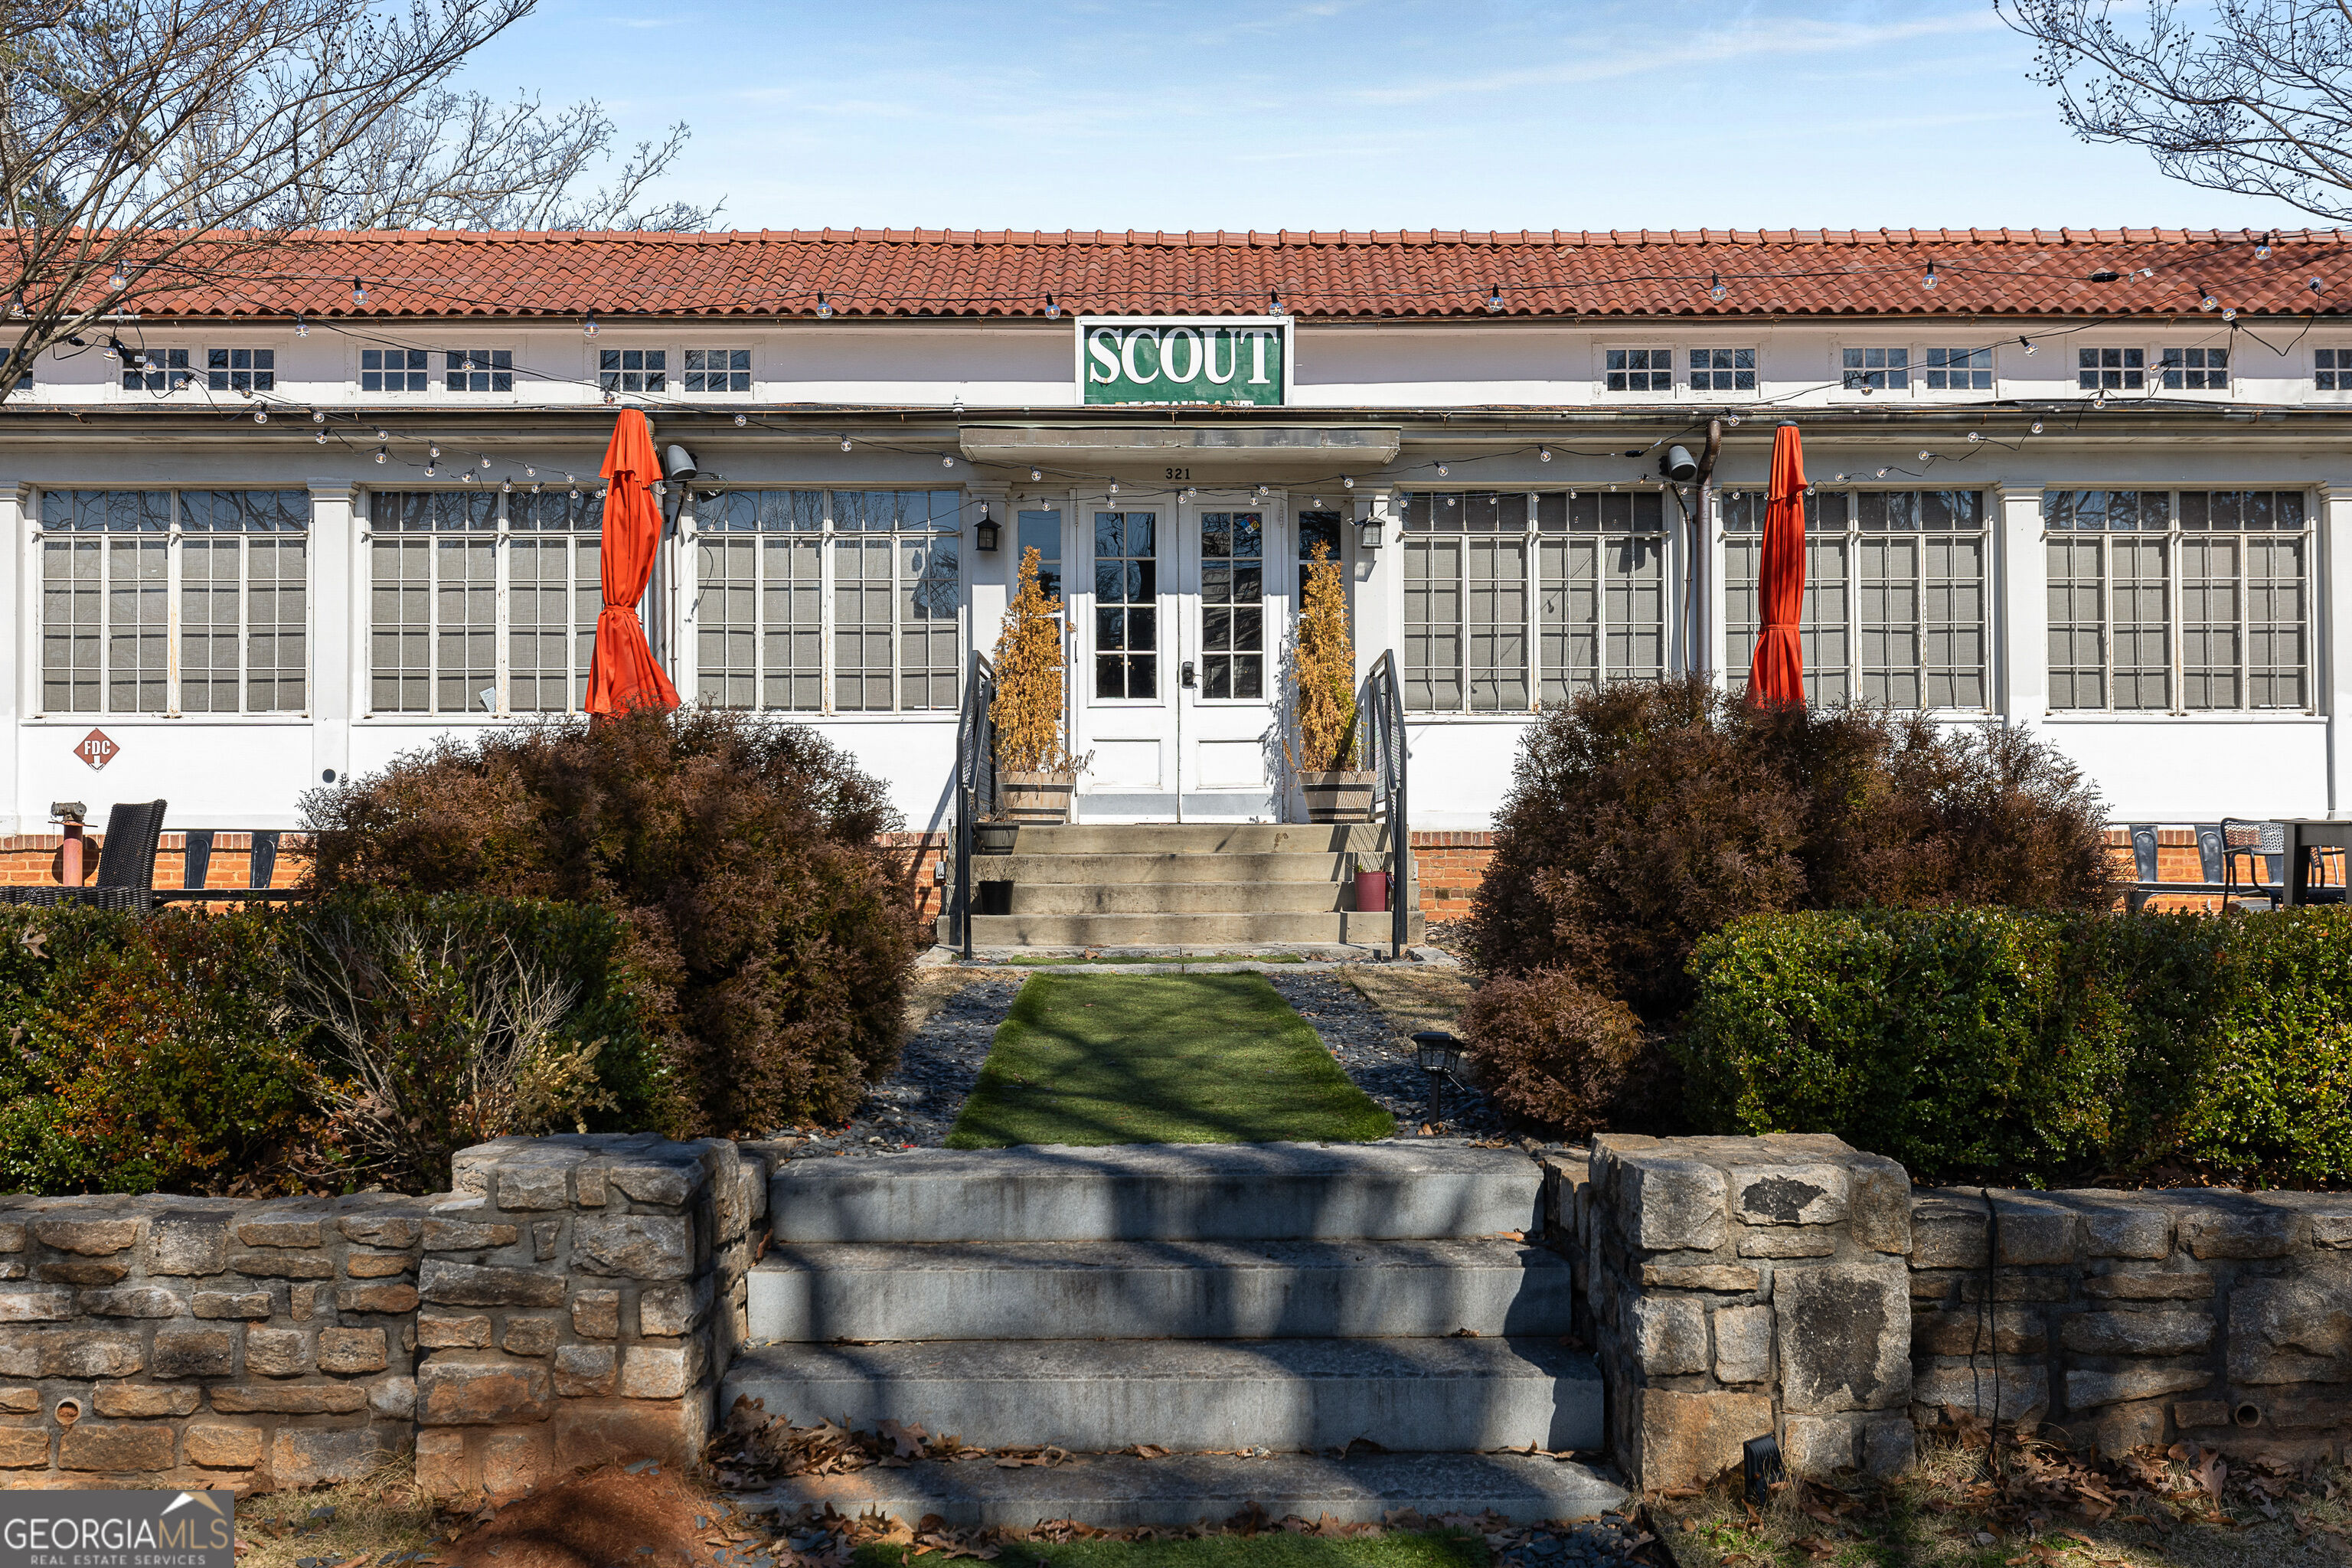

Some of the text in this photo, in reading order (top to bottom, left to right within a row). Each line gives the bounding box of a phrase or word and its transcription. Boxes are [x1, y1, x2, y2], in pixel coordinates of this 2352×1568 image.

[1088, 327, 1278, 384] SCOUT
[1165, 467, 1191, 480] 321
[84, 740, 111, 755] FDC
